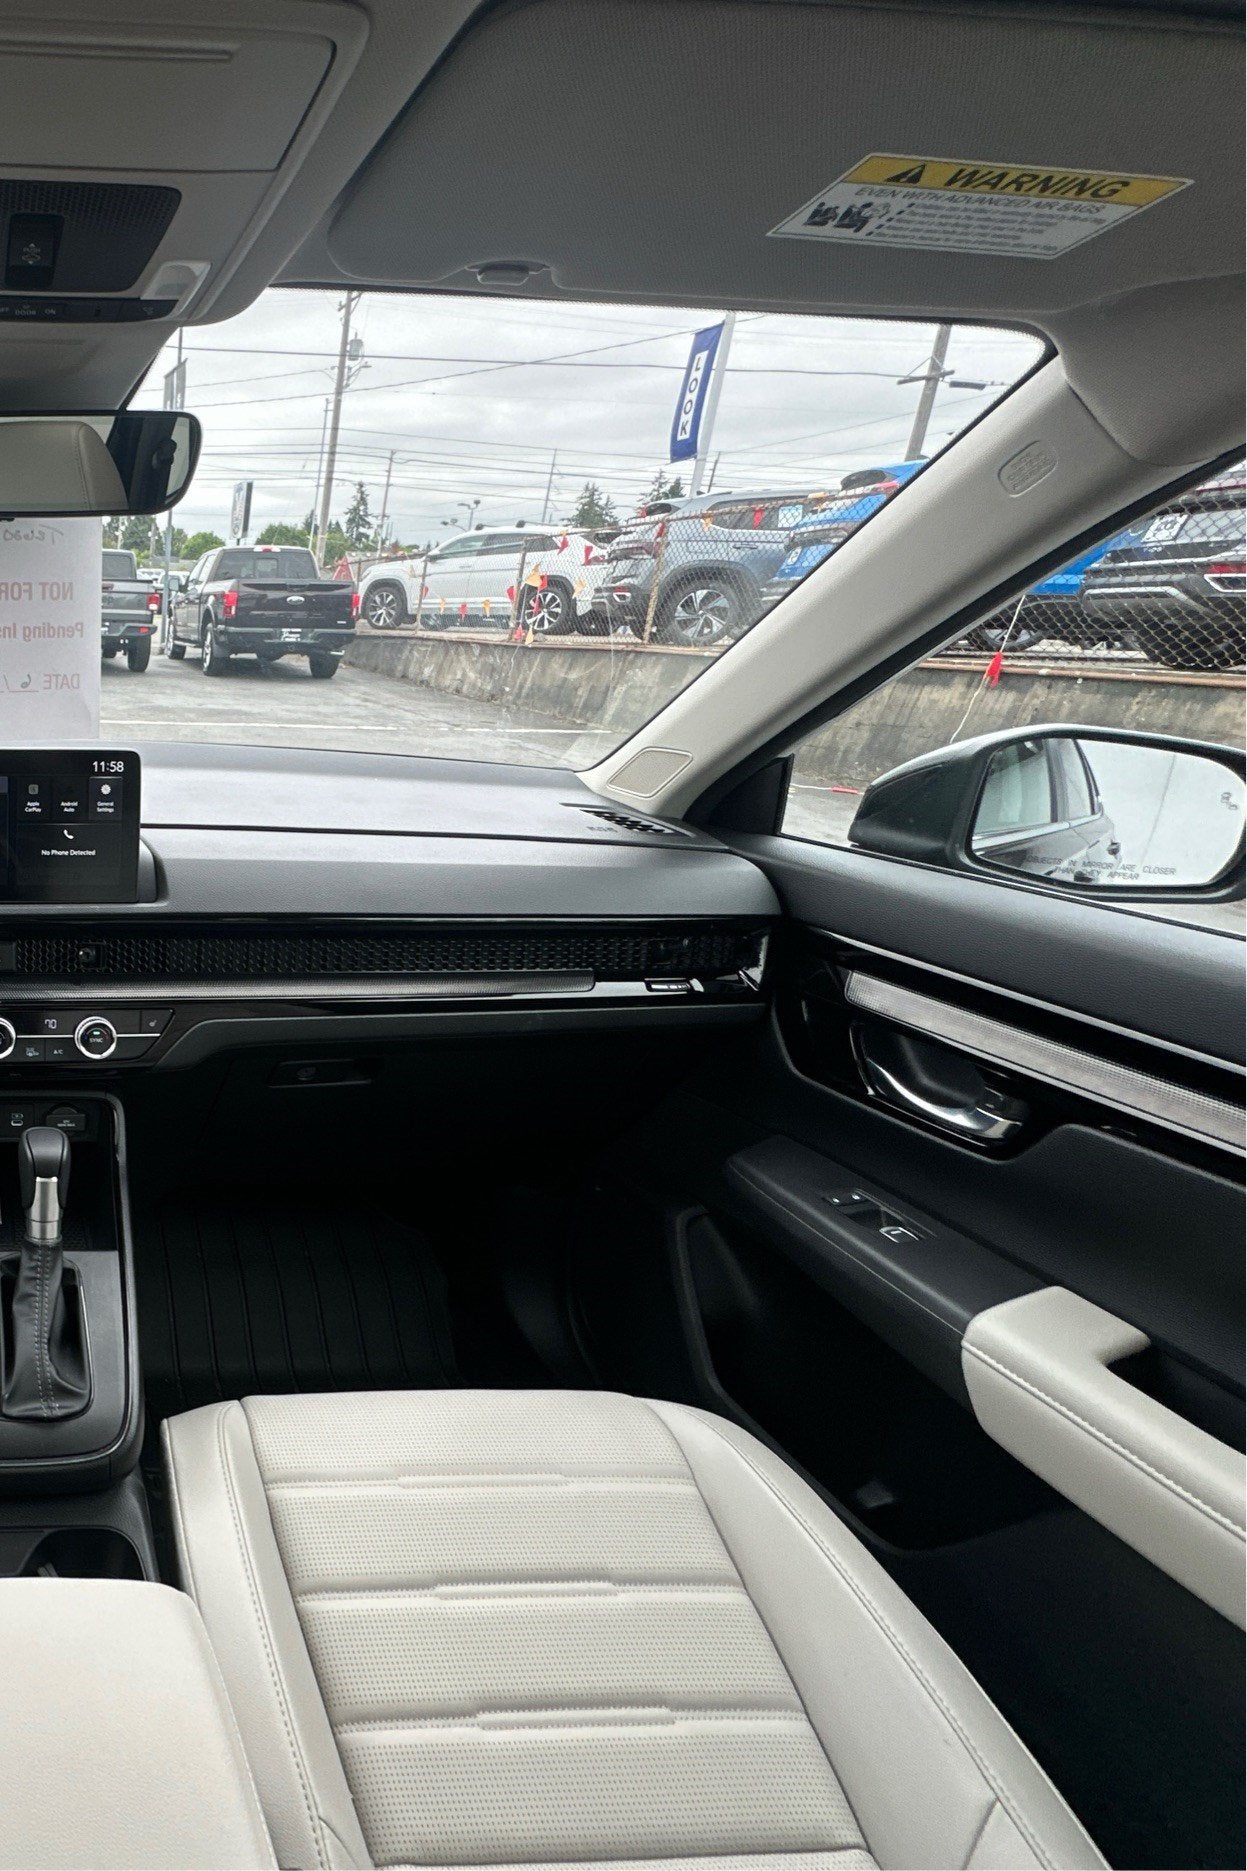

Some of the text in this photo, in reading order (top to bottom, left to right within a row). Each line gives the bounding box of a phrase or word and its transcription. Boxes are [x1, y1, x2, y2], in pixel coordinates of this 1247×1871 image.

[944, 167, 1131, 199] WARNING
[854, 186, 902, 198] EVEN
[901, 190, 946, 202] WITH
[945, 193, 1032, 208] ADVANCED
[1056, 202, 1106, 215] BAGS
[679, 355, 701, 437] LOOK
[92, 761, 124, 773] 11:58
[1082, 861, 1113, 870] MIRROR
[1120, 864, 1137, 872] ARE
[1142, 866, 1176, 875] CLOSER
[1107, 871, 1139, 880] APPEAR
